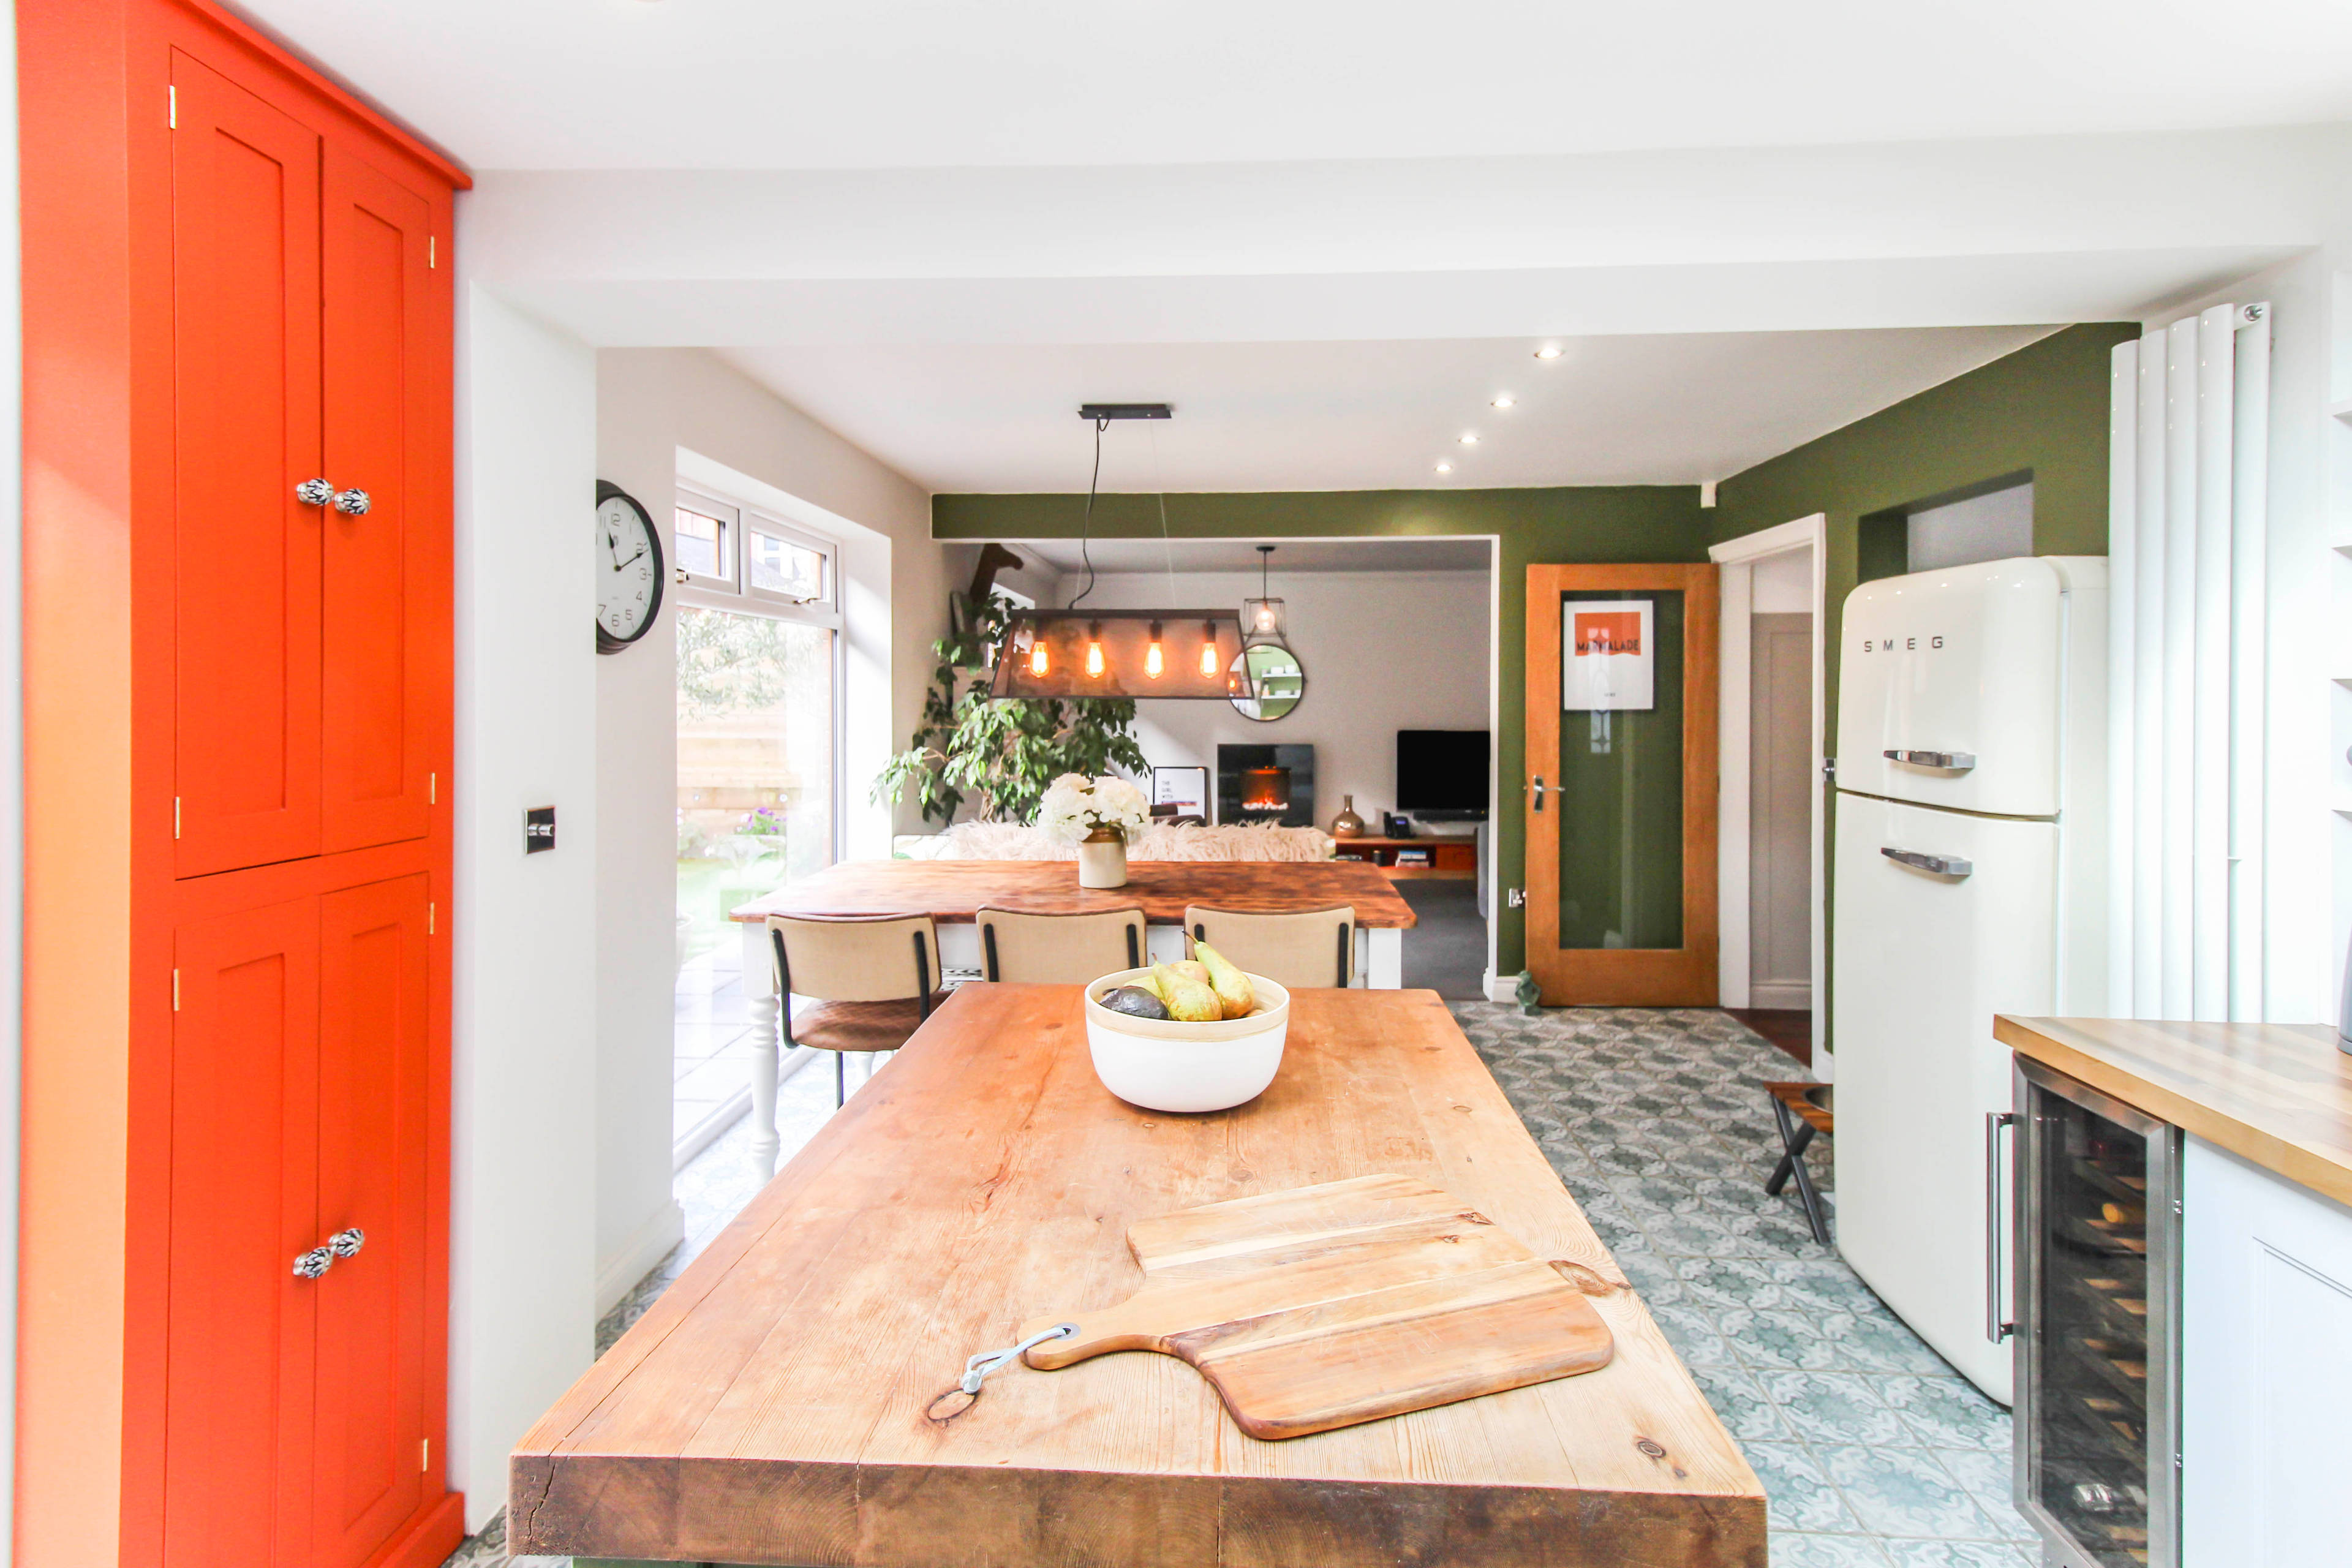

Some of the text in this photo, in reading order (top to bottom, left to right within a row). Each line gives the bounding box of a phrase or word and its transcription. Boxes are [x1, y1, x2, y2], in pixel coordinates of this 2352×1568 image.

[639, 568, 647, 581] 3
[635, 590, 643, 601] 4
[598, 604, 606, 617] 7
[625, 609, 633, 621] 5
[611, 614, 620, 627] 6
[1577, 639, 1639, 652] MARMALADE
[1864, 636, 1943, 652] SMEG
